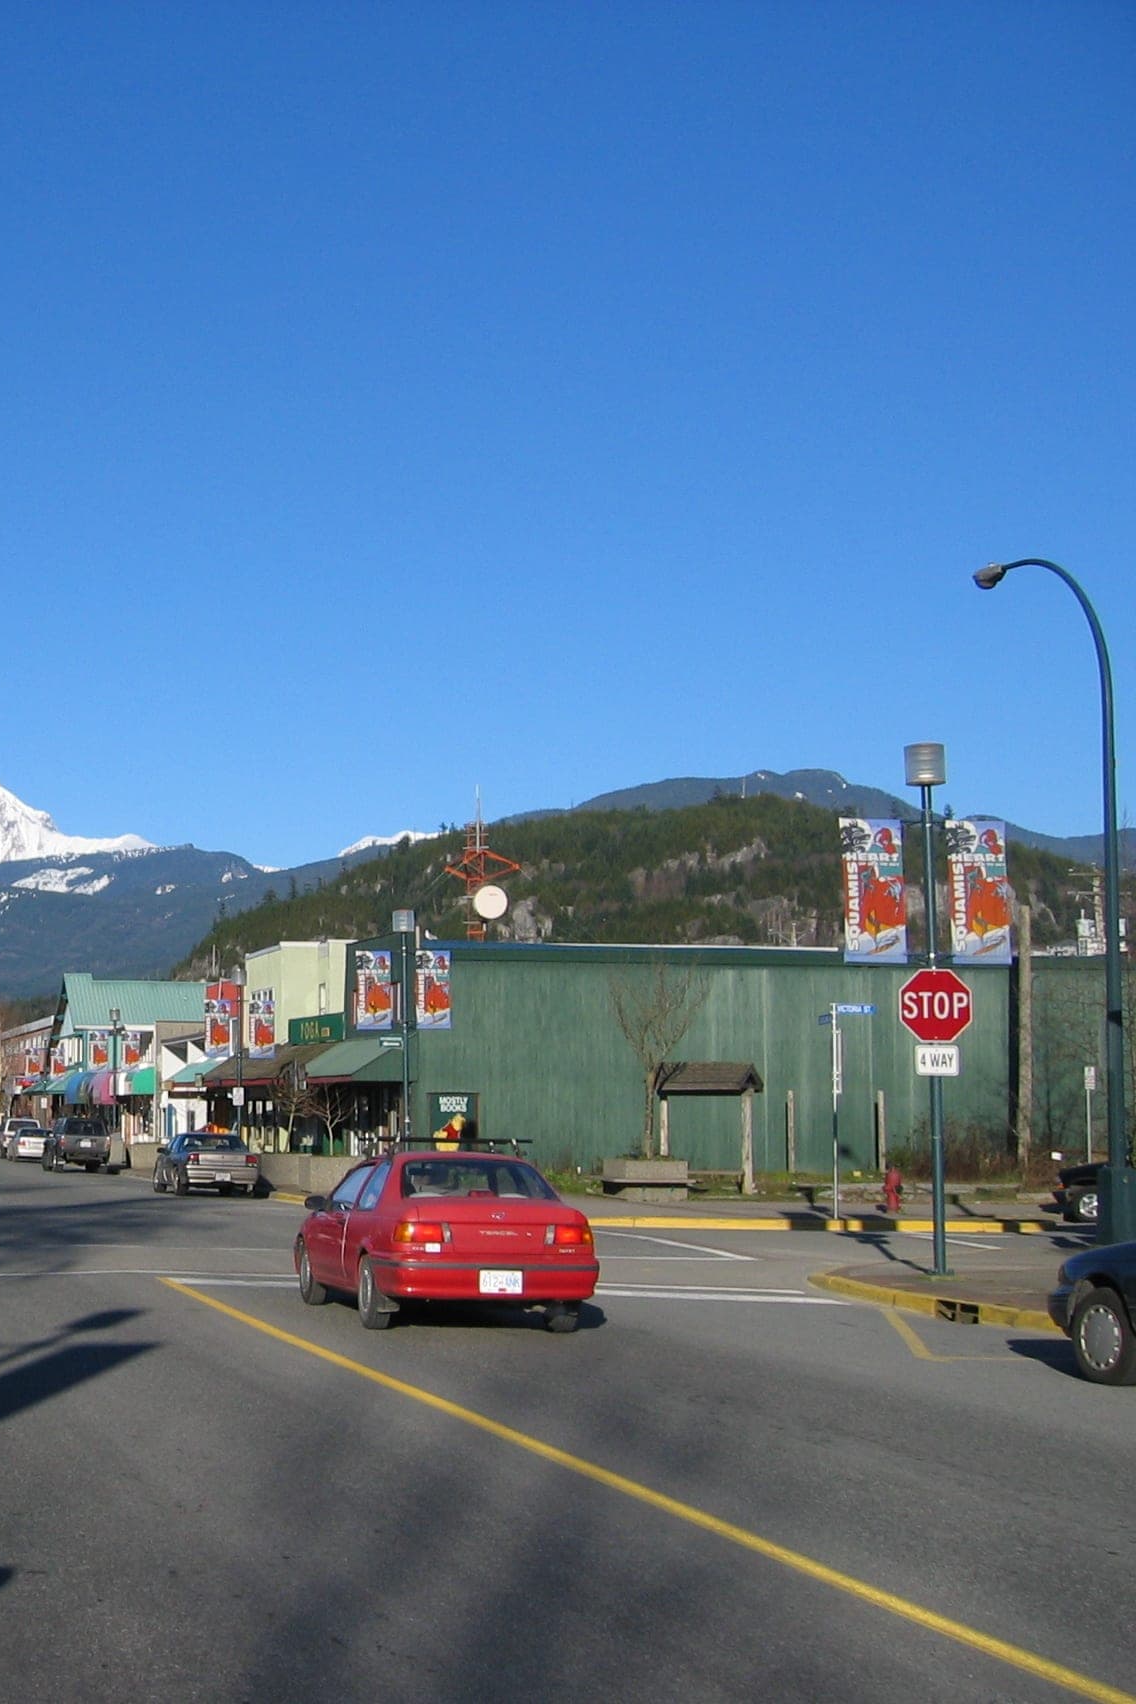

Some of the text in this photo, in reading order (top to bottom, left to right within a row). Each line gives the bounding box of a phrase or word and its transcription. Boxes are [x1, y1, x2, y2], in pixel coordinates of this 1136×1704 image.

[846, 851, 899, 862] HEART
[951, 852, 1005, 863] HEART
[837, 1004, 862, 1013] VICTORIA
[903, 991, 968, 1020] STOP
[920, 1053, 954, 1067] 4 WAY
[438, 1095, 469, 1105] MOSTLY
[440, 1104, 468, 1112] BOOKS
